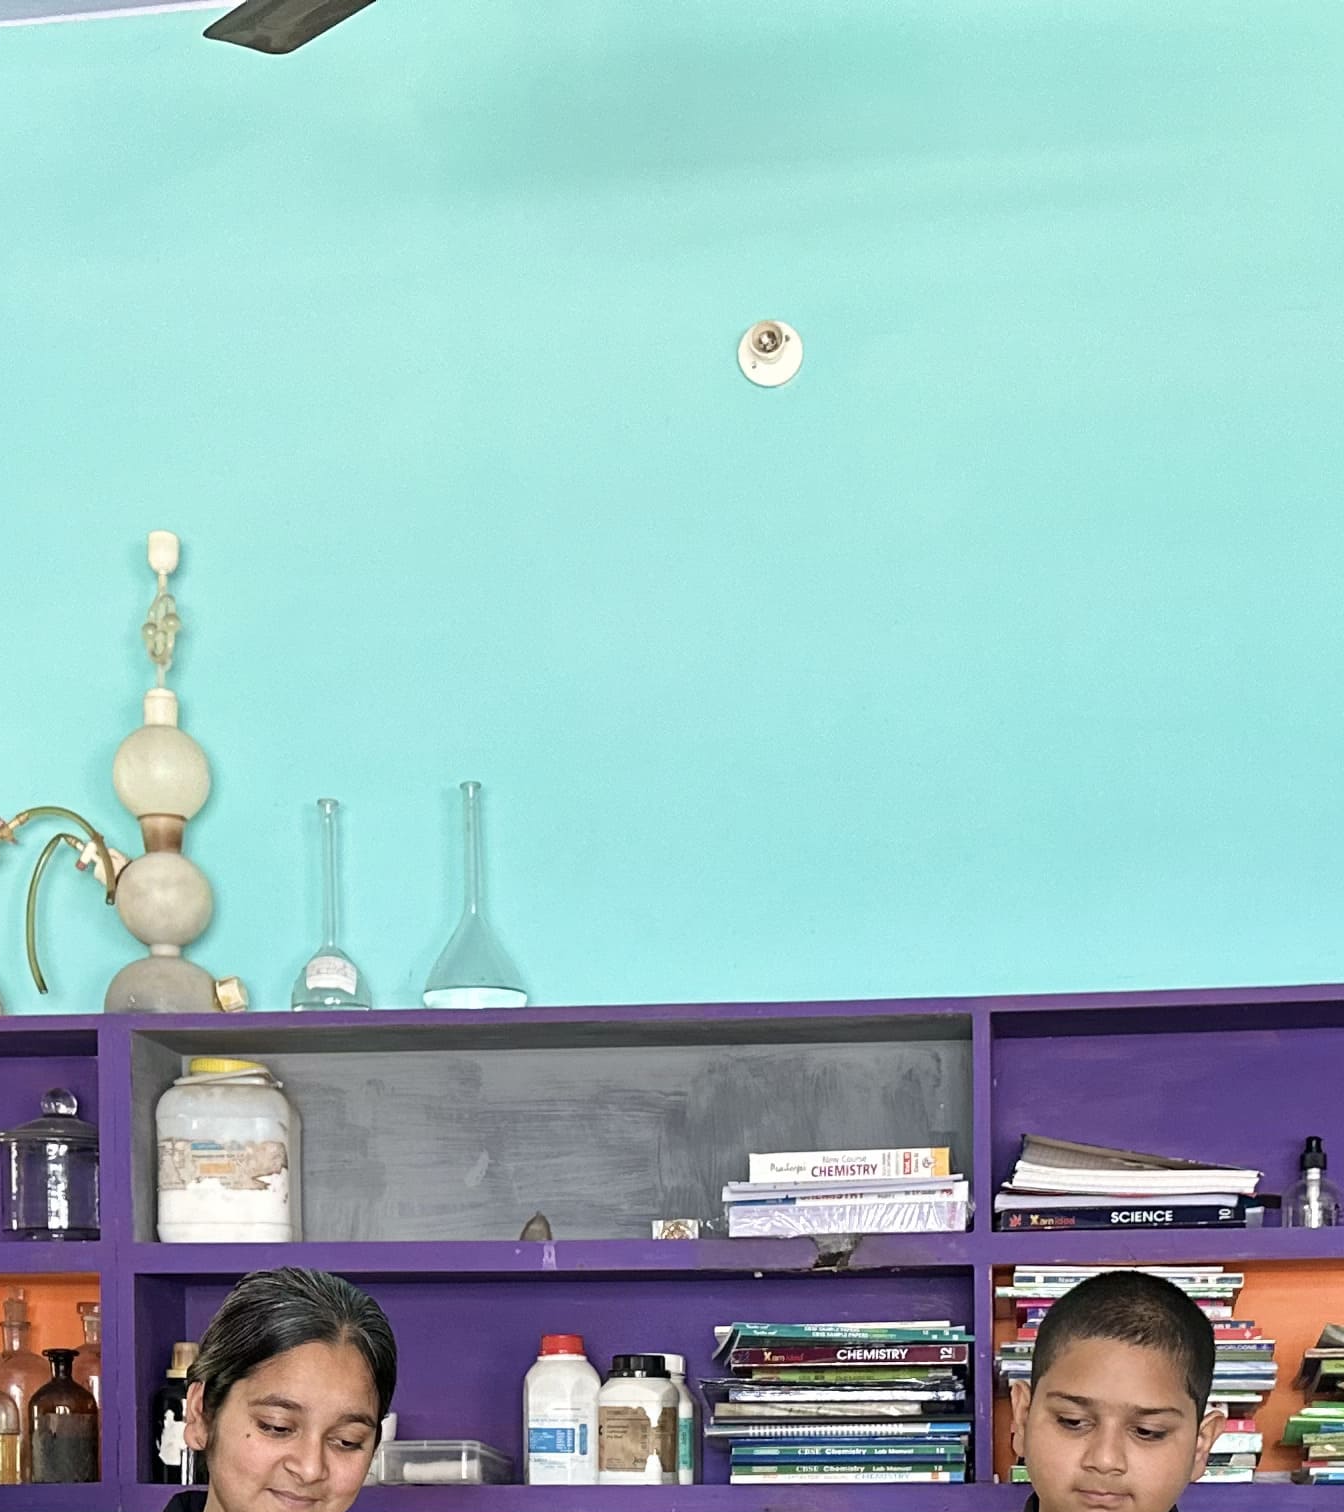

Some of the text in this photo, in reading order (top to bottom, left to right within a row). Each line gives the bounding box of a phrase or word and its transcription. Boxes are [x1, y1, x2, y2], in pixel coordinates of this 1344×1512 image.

[811, 1164, 877, 1177] CHEMISTRY
[1110, 1210, 1173, 1224] SCIENCE
[1218, 1209, 1232, 1220] 10
[836, 1349, 908, 1360] CHEMISTRY
[940, 1347, 953, 1359] 12
